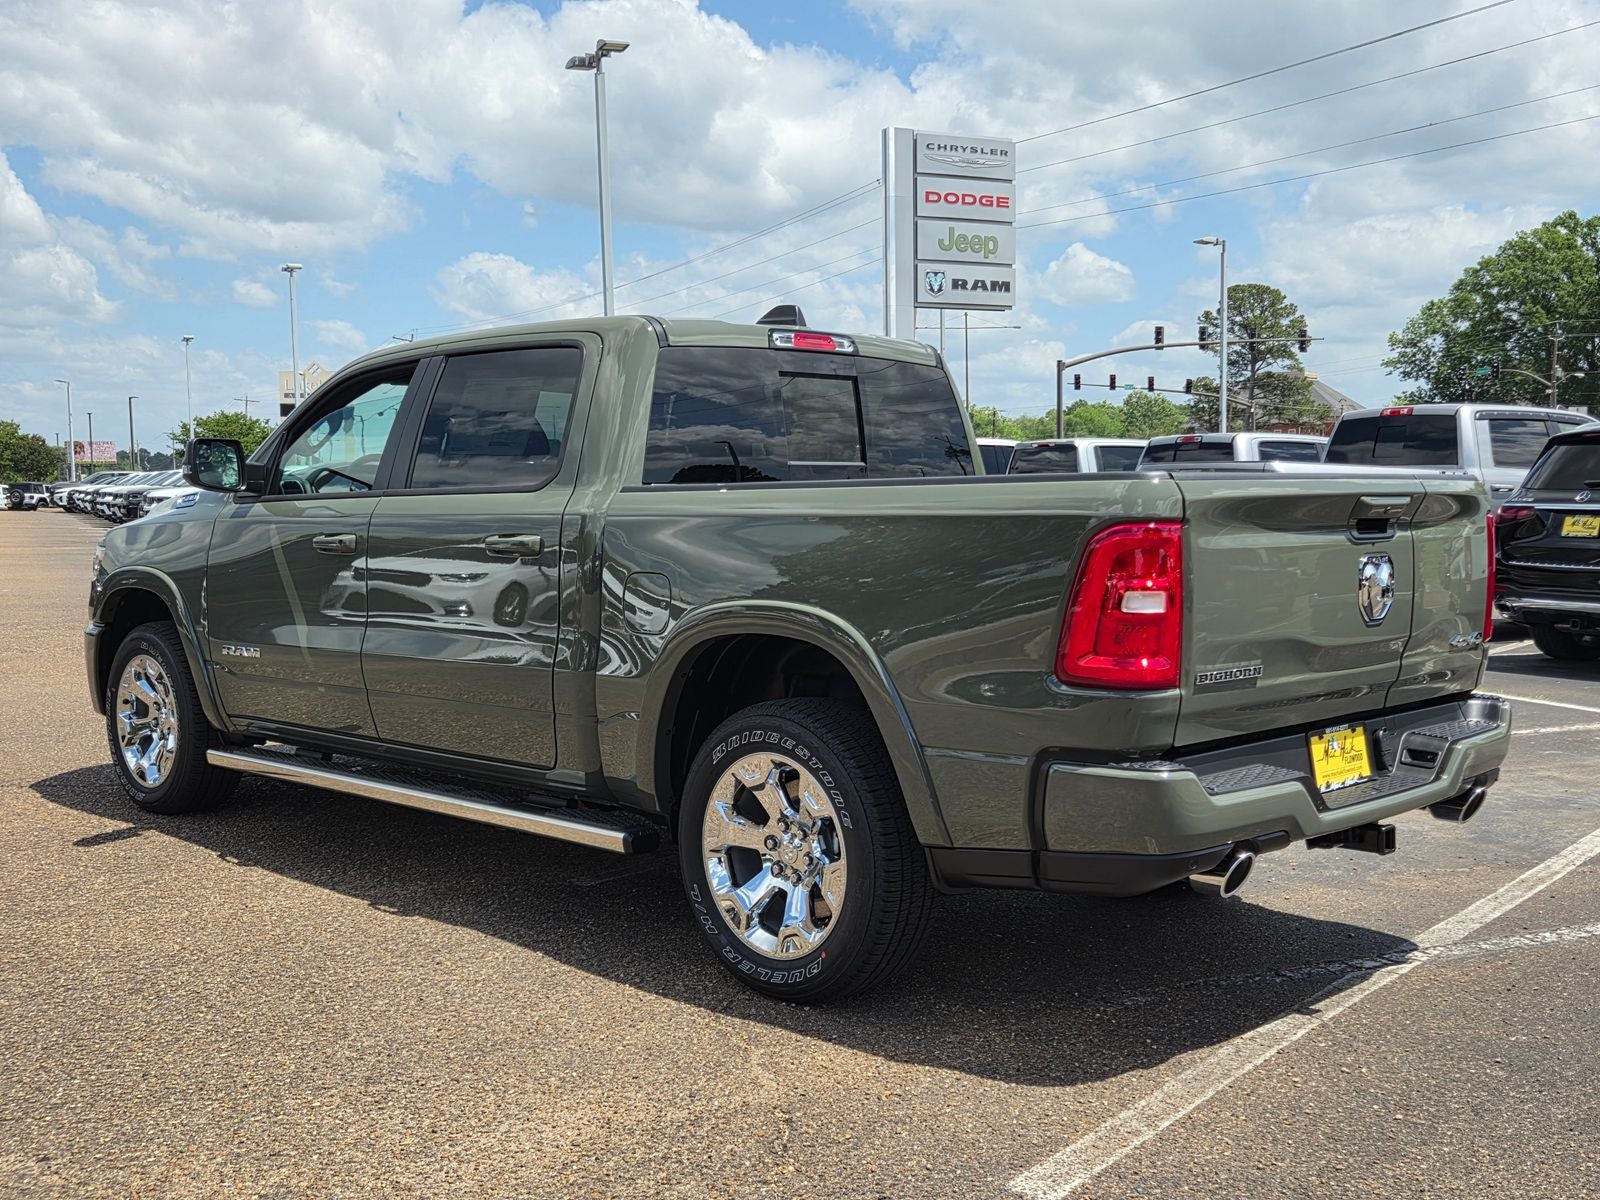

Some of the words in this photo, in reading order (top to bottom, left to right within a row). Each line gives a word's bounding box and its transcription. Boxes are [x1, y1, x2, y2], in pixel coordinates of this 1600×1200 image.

[925, 142, 1009, 158] CHRYSLER
[925, 191, 1010, 209] DODGE
[937, 226, 999, 259] Jeep
[951, 278, 1011, 293] RAM
[221, 645, 261, 658] RAM
[1195, 665, 1263, 685] BIGHORN
[712, 730, 853, 829] BRIDGESTONE
[722, 945, 823, 984] DUELER
